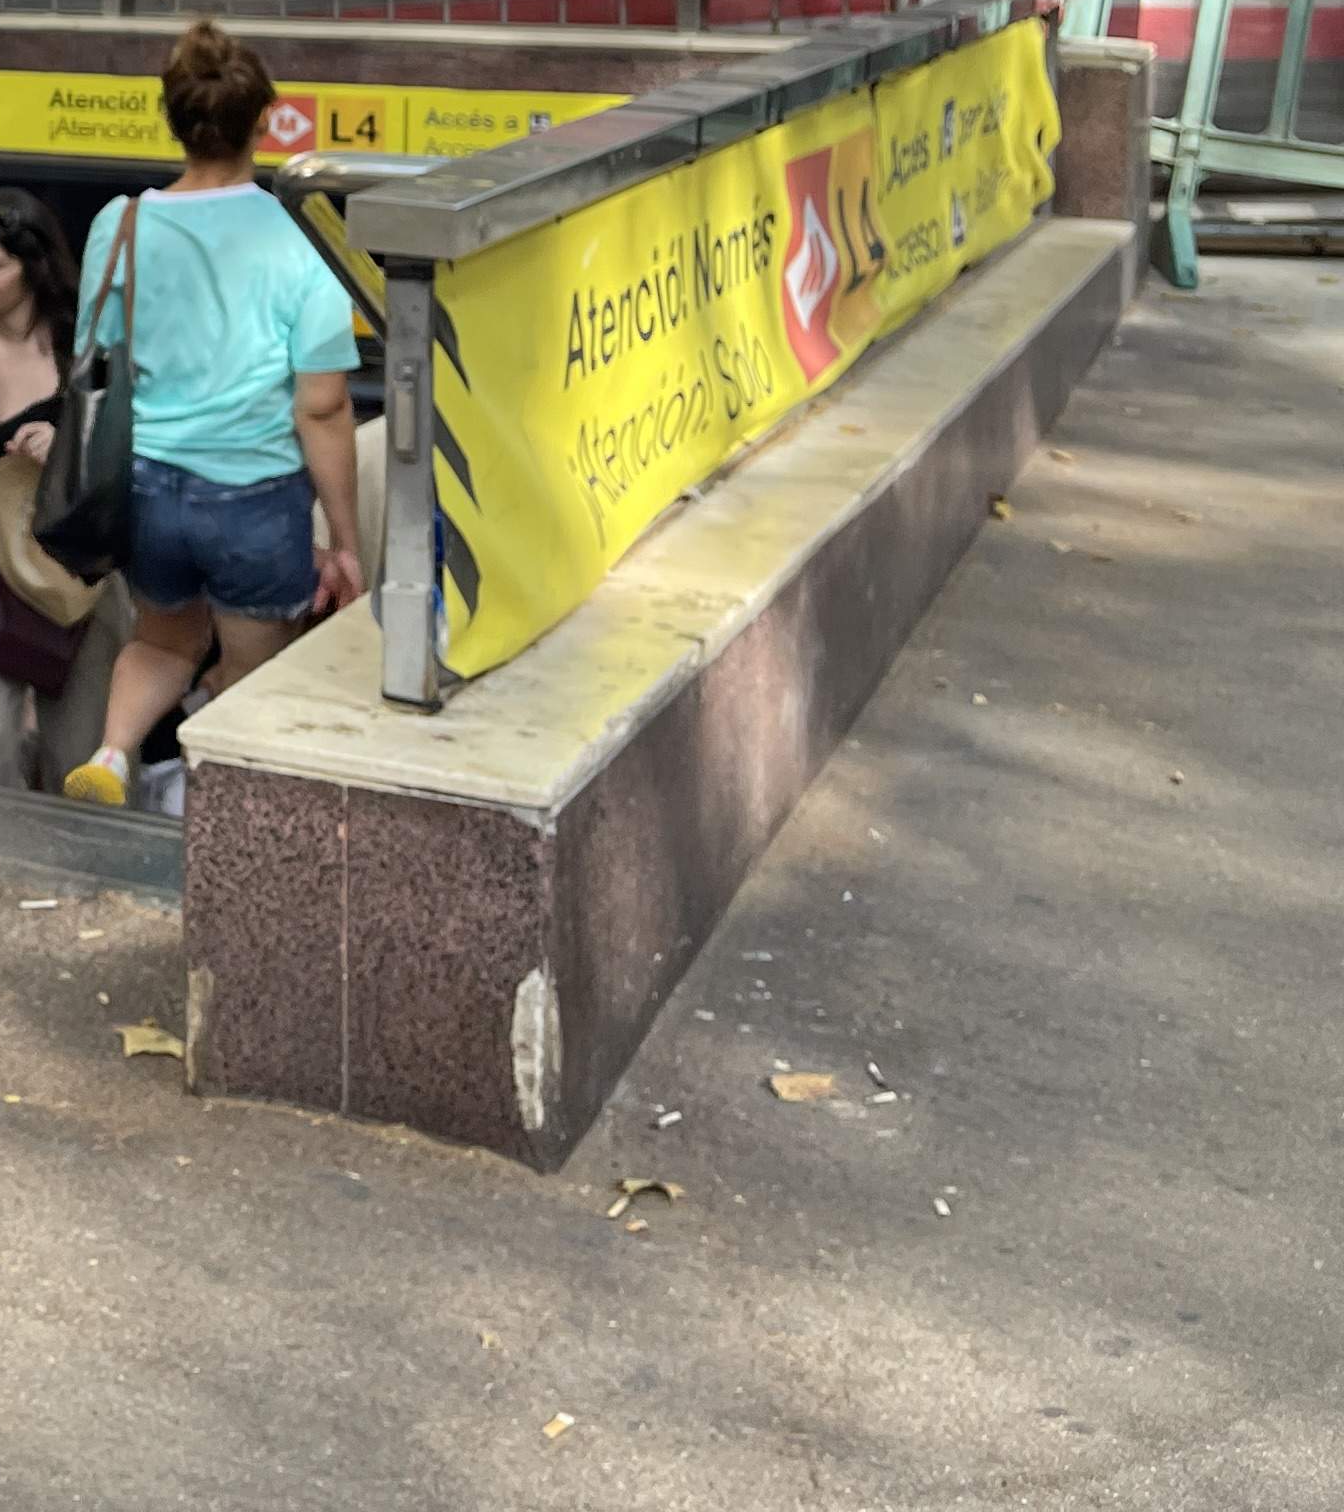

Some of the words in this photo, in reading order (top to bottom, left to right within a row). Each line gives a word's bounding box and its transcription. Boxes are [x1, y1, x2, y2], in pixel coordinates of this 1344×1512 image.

[49, 88, 146, 111] Atenció!
[330, 112, 377, 143] L4
[425, 106, 495, 131] Accés
[504, 114, 519, 130] a
[564, 234, 688, 391] Atenció!
[694, 196, 775, 312] Només
[569, 350, 714, 551] ¡Atención!
[715, 323, 775, 420] Solo
